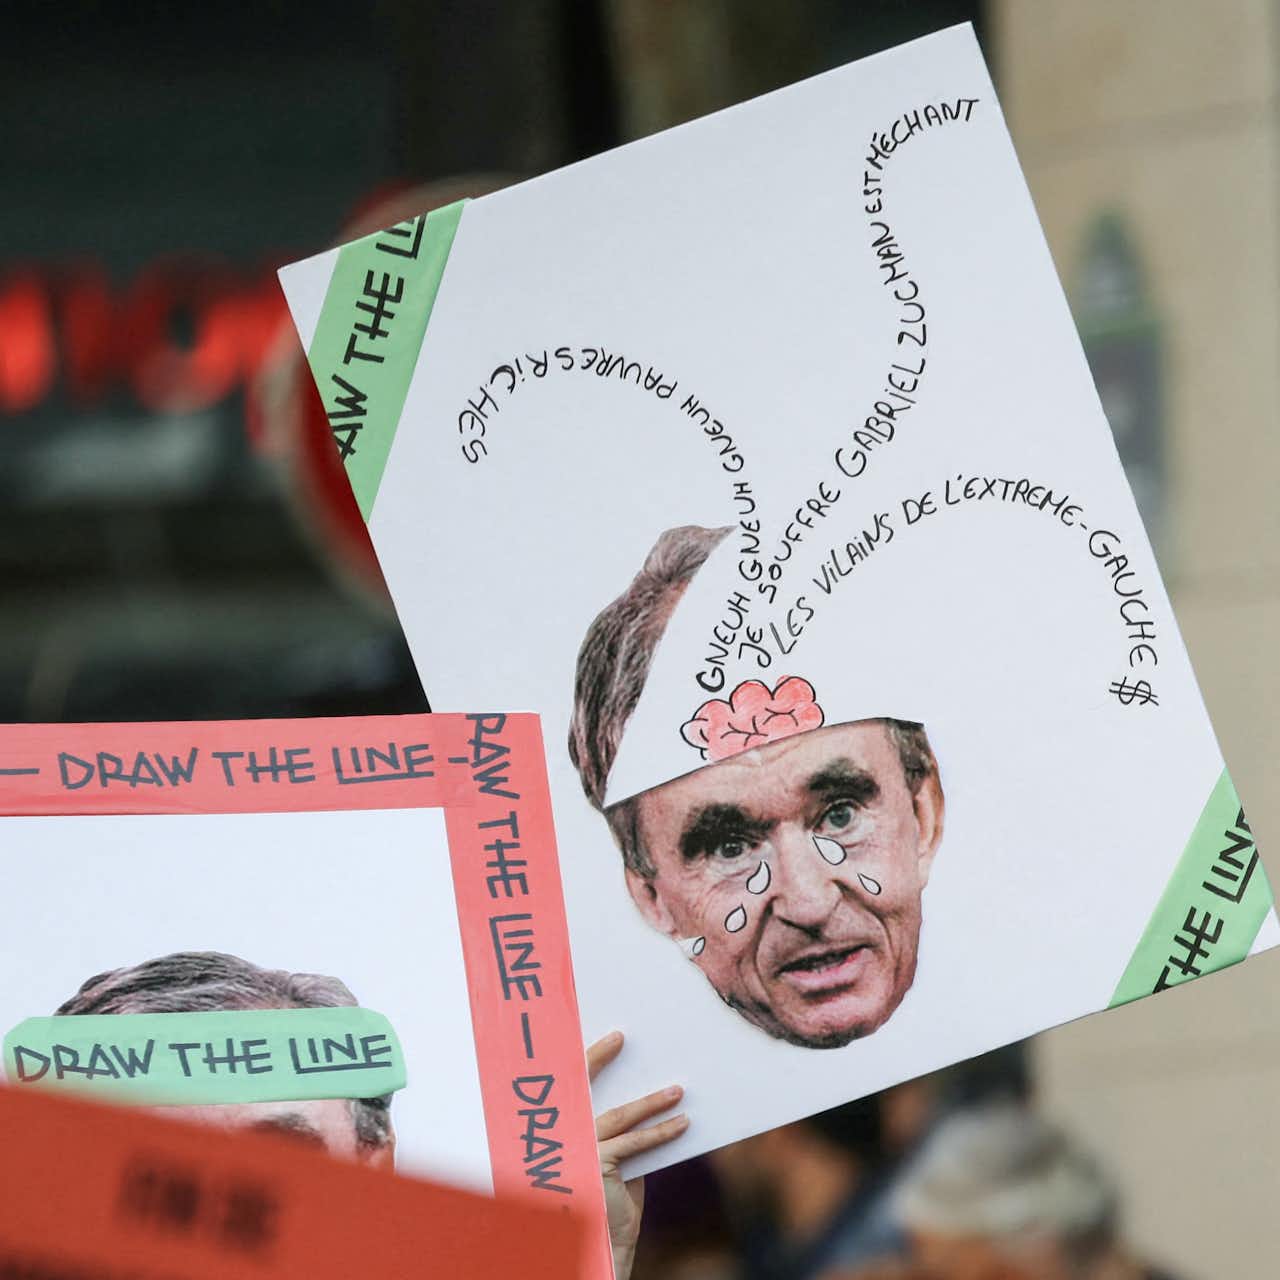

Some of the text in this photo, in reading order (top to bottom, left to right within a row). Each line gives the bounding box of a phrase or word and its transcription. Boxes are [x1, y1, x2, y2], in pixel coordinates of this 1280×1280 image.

[866, 99, 979, 170] MÉCHANT
[863, 171, 883, 214] EST
[327, 213, 428, 463] AW THE LI
[555, 347, 678, 399] PAUVRES
[734, 482, 763, 581] GNEUH
[759, 482, 841, 603] SOUFFRE
[770, 596, 814, 654] LES
[902, 492, 937, 525] DE
[696, 592, 750, 692] GNEUH
[738, 626, 771, 668] JE
[57, 743, 435, 790] DRAW THE LINE
[466, 713, 573, 1194] RAW THE LINE DRAW
[13, 1031, 394, 1082] DRAW THE LINE
